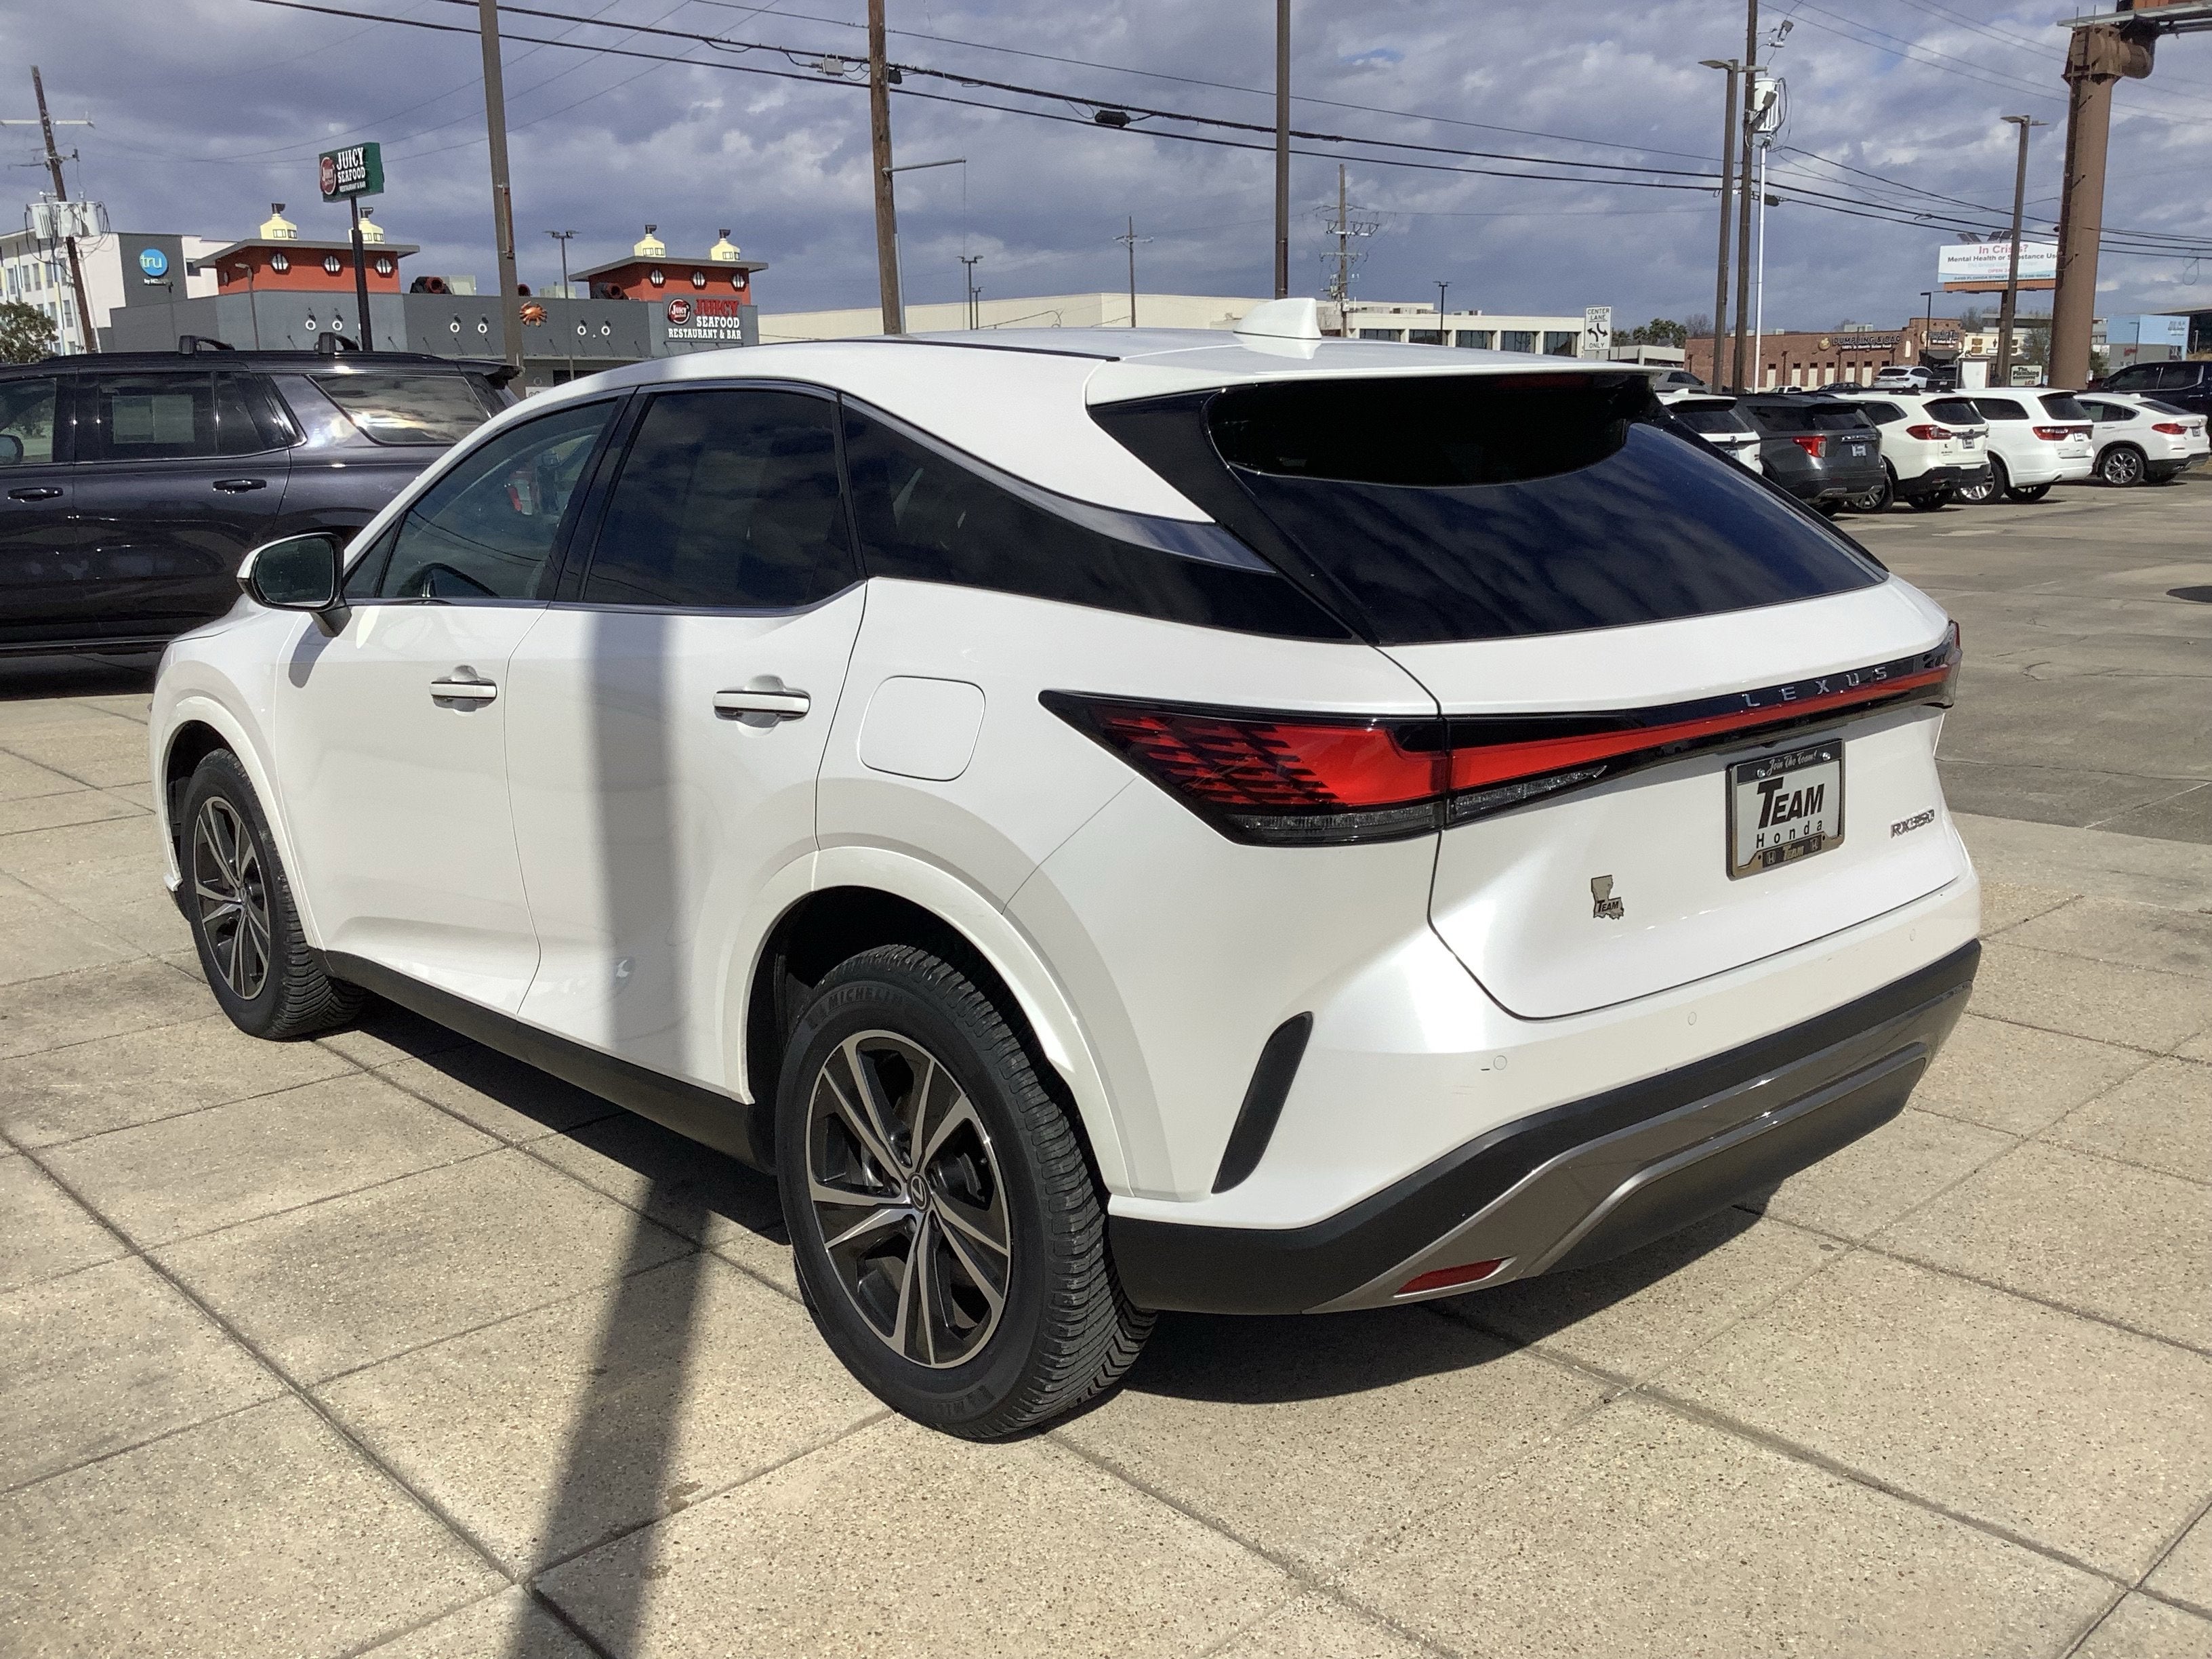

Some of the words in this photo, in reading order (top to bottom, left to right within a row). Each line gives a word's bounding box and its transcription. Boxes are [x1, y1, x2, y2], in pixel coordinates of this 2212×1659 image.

[336, 147, 364, 170] JUICY
[337, 166, 366, 184] SEAFOOD
[1979, 246, 1989, 254] In
[140, 254, 162, 268] tru
[693, 299, 739, 316] JUICY
[696, 316, 740, 328] SEAFOOD
[668, 328, 718, 338] RESTAURANT
[719, 329, 724, 339] &
[726, 329, 742, 340] BAR
[1742, 666, 1887, 708] LEXUS
[1765, 758, 1784, 777] Join
[1784, 755, 1797, 769] The
[1797, 750, 1818, 765] Team!
[1757, 777, 1825, 830] TEAM
[1756, 820, 1823, 848] Honda
[1782, 844, 1804, 861] TEAM
[1597, 899, 1619, 912] TEAM
